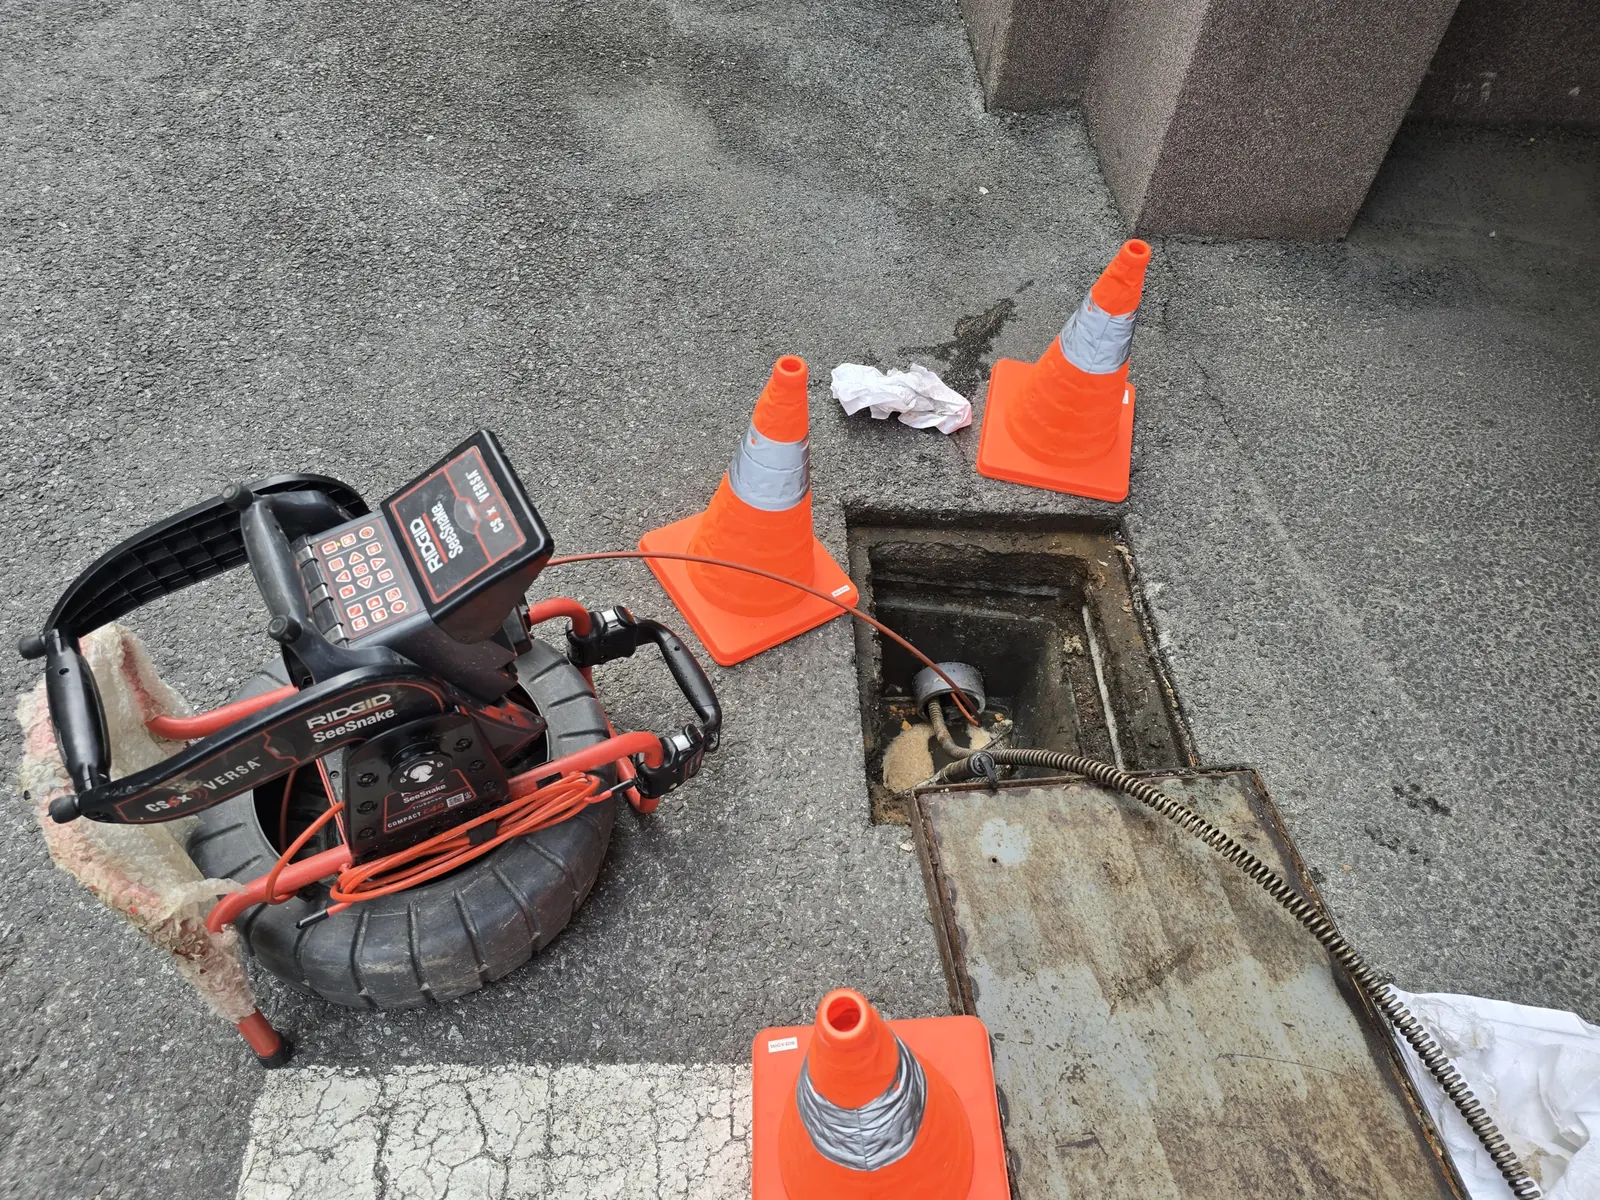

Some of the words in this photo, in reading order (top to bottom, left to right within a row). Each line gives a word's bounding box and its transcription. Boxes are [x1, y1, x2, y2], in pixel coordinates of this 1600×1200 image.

[409, 516, 443, 574] RIDGID
[431, 501, 464, 559] SeeSnake
[306, 693, 391, 729] RIDGID
[313, 709, 395, 743] SeeSnake
[403, 784, 446, 803] SeeSnake
[387, 811, 421, 828] COMPACT
